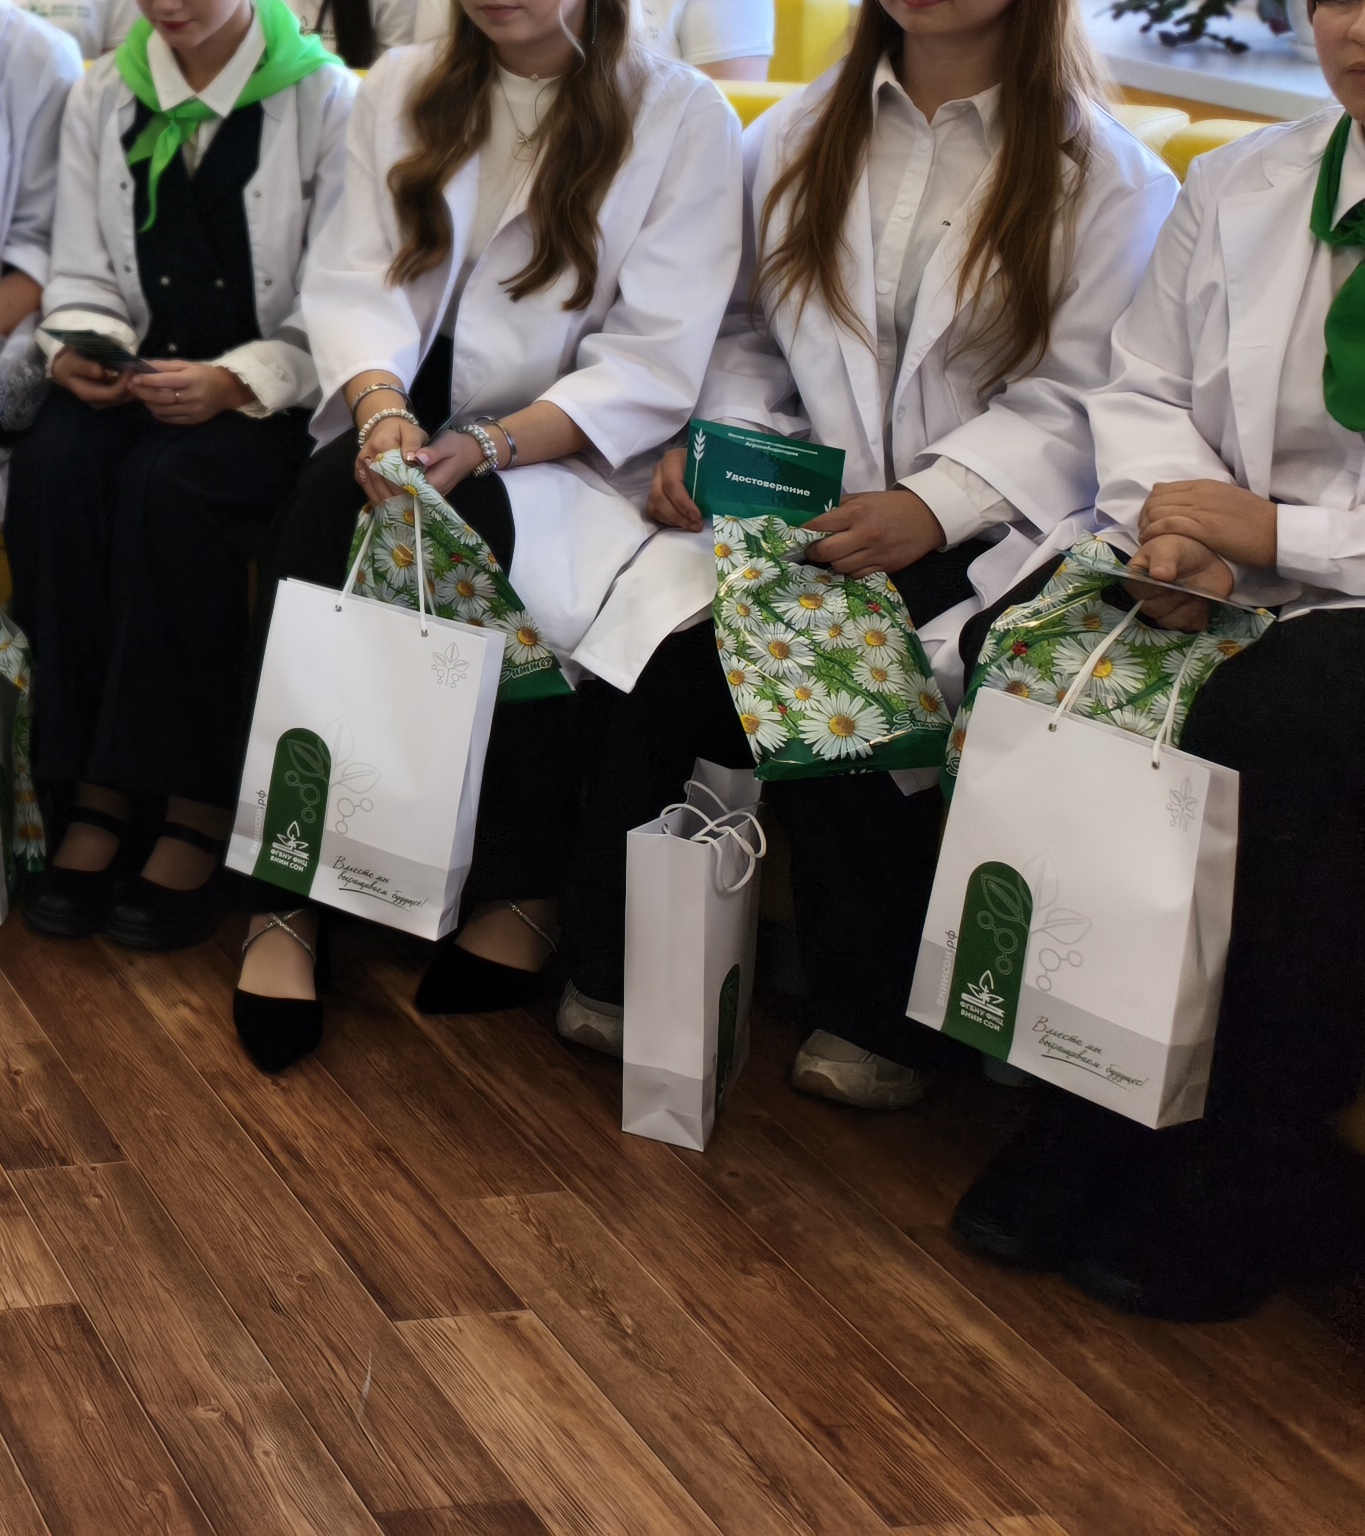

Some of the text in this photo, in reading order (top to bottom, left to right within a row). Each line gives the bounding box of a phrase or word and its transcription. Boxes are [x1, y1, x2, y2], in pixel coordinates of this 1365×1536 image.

[725, 470, 812, 498] Удостоверение
[289, 862, 305, 873] СОИ
[332, 855, 390, 884] Вместе мы
[1032, 1015, 1084, 1047] Вместе
